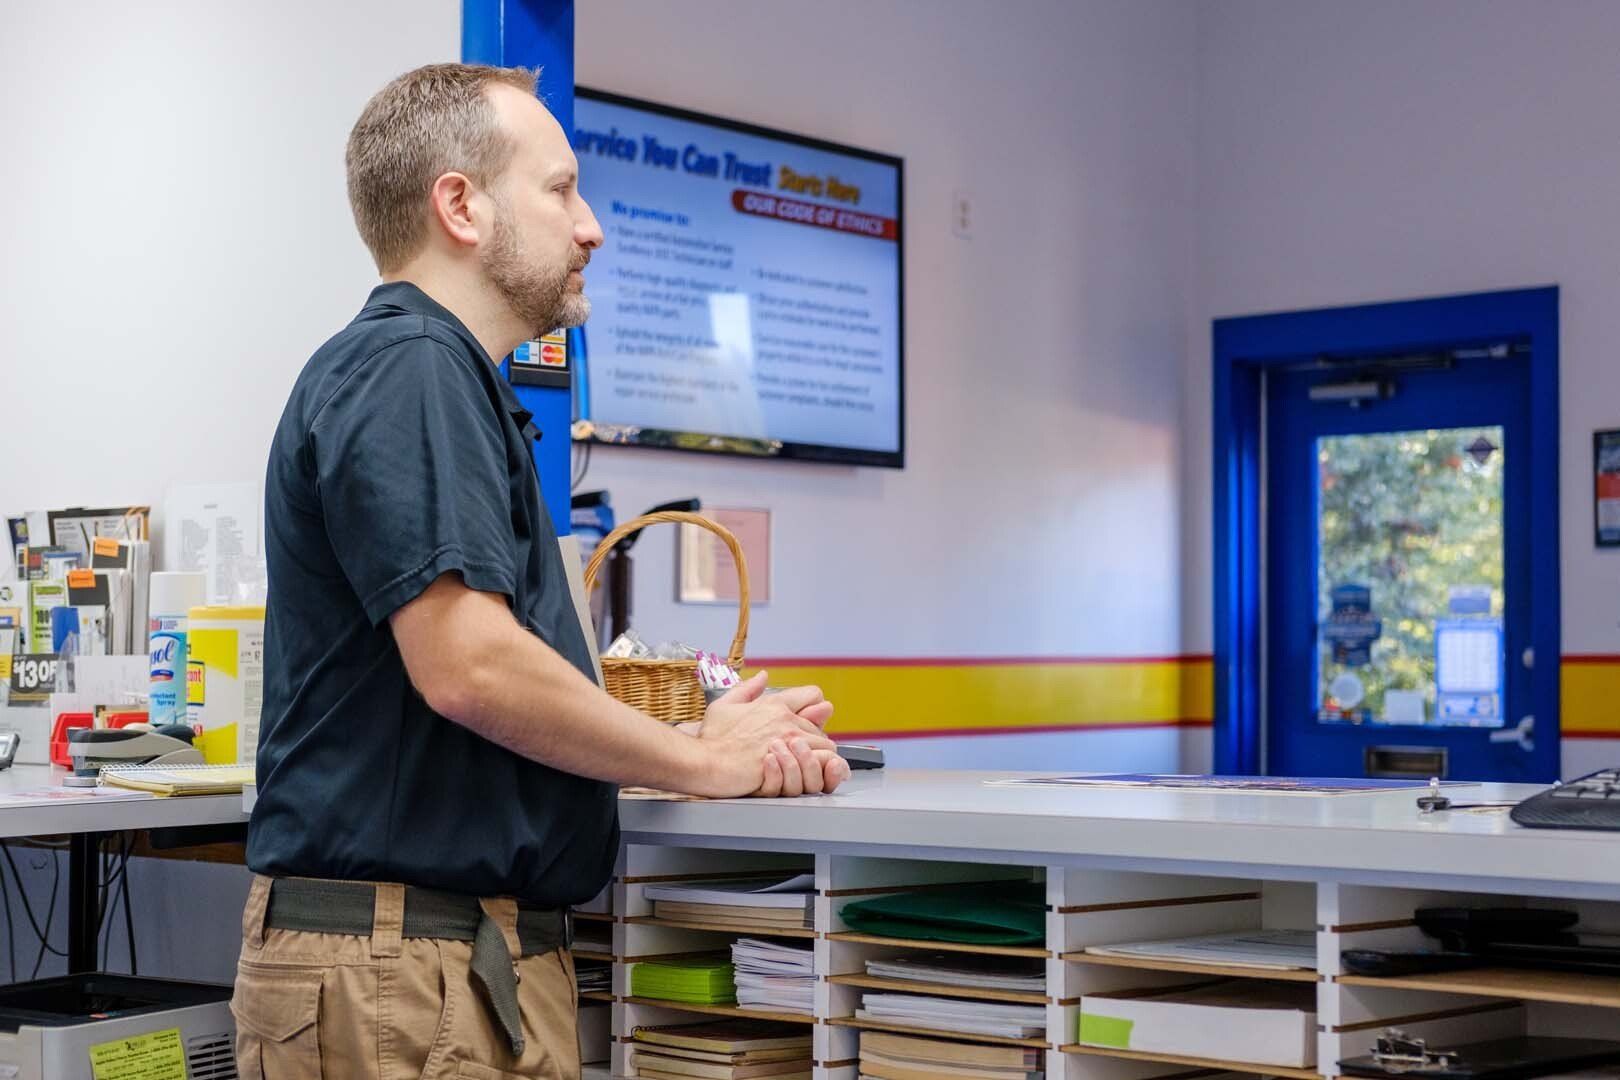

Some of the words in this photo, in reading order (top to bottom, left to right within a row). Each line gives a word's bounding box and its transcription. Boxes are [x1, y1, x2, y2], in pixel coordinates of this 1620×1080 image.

[574, 126, 637, 165] ervice
[642, 135, 677, 170] You
[682, 144, 719, 179] Can
[723, 152, 772, 189] Trust
[743, 193, 776, 214] OUR
[778, 197, 814, 223] CODE
[816, 205, 835, 224] OF
[837, 209, 886, 237] ETHICS
